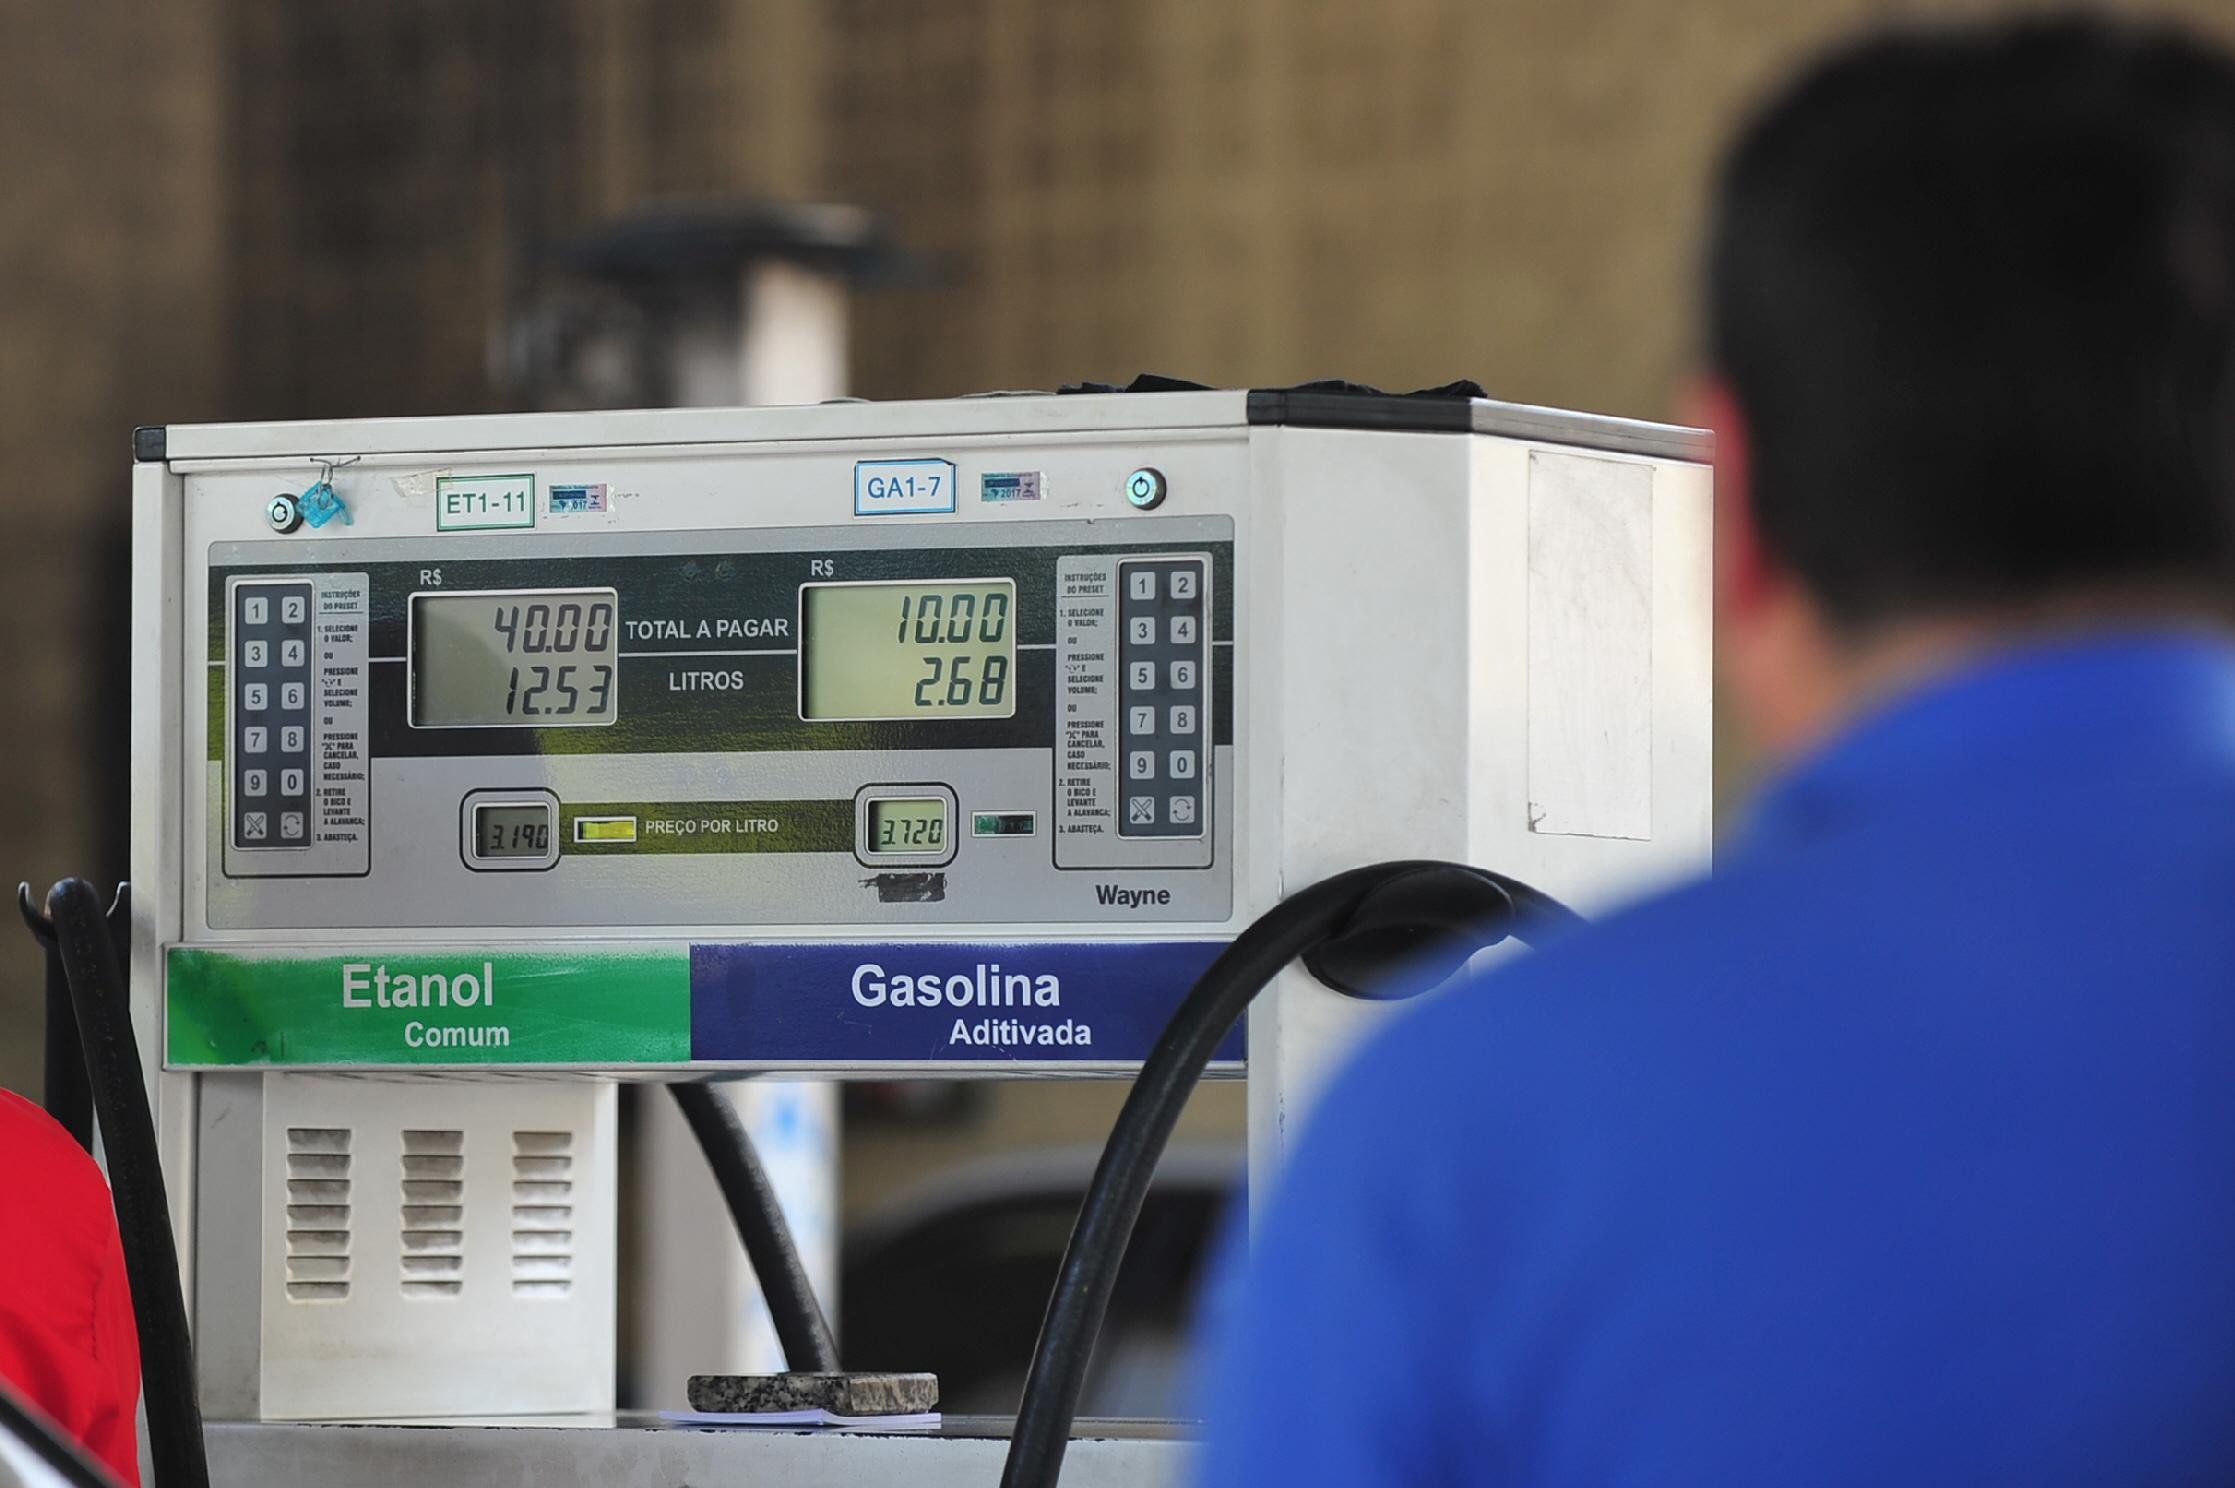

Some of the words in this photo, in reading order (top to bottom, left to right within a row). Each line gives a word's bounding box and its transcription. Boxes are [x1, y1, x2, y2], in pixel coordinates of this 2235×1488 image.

[867, 476, 941, 498] GA1-7
[1001, 489, 1021, 498] 2017
[447, 491, 527, 514] ET1-11
[571, 500, 587, 510] 017
[811, 559, 834, 577] R$
[420, 569, 442, 586] R$
[1139, 579, 1146, 593] 1
[1178, 577, 1188, 593] 2
[252, 604, 259, 619] 1
[289, 603, 298, 617] 2
[898, 593, 1008, 644] 10.00
[494, 603, 613, 653] 40.00
[626, 620, 690, 640] TOTAL
[696, 620, 711, 638] A
[716, 619, 789, 638] PAGAR
[1138, 623, 1147, 638] 3
[1178, 622, 1188, 637] 4
[252, 646, 261, 661] 3
[288, 646, 298, 660] 4
[669, 671, 743, 691] LITROS
[914, 655, 1008, 706] 2.68
[1138, 668, 1147, 683] 5
[1178, 667, 1188, 682] 6
[252, 690, 261, 704] 5
[288, 689, 298, 703] 6
[506, 665, 613, 715] 12.53
[1138, 713, 1147, 728] 7
[1177, 712, 1187, 727] 8
[251, 733, 260, 747] 7
[288, 732, 297, 747] 8
[1137, 758, 1146, 773] 9
[1177, 757, 1187, 773] 0
[250, 775, 260, 790] 9
[287, 775, 297, 790] 0
[646, 820, 696, 836] PREÇO
[701, 820, 731, 833] POR
[736, 819, 778, 833] LITRO
[1096, 884, 1170, 908] Wayne
[342, 962, 494, 1009] Etanol
[852, 964, 1060, 1008] Gasolina
[404, 1022, 509, 1048] Comum
[949, 1019, 1091, 1046] Aditivada
